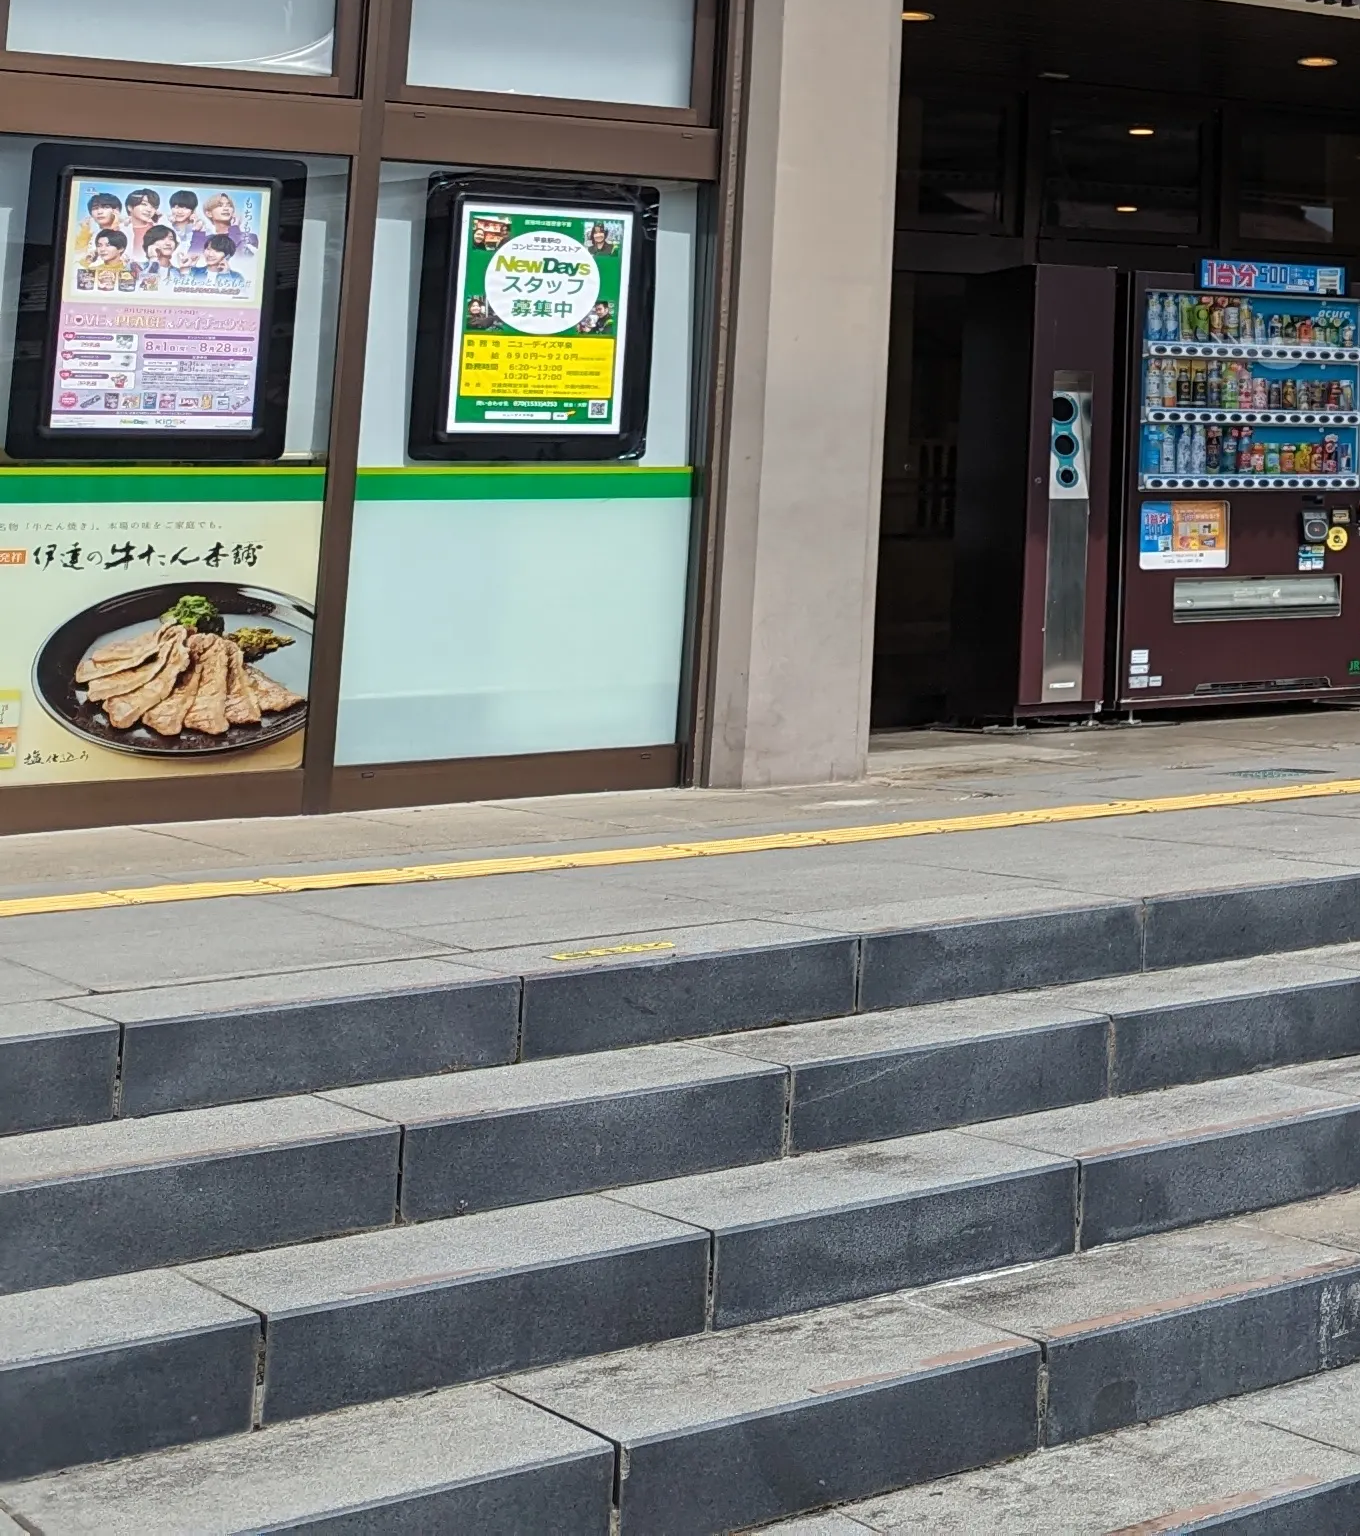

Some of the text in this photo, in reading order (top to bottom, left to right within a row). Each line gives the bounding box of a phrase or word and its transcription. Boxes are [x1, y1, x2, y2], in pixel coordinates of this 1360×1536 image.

[511, 243, 582, 253] コンビニエンスストア
[495, 255, 591, 276] NewDays
[502, 275, 585, 295] スタッフ
[511, 298, 573, 319] 募集中
[1318, 309, 1351, 321] acure
[507, 340, 573, 349] ニューデイズ平泉
[32, 540, 264, 572] 伊達の牛たん本舗
